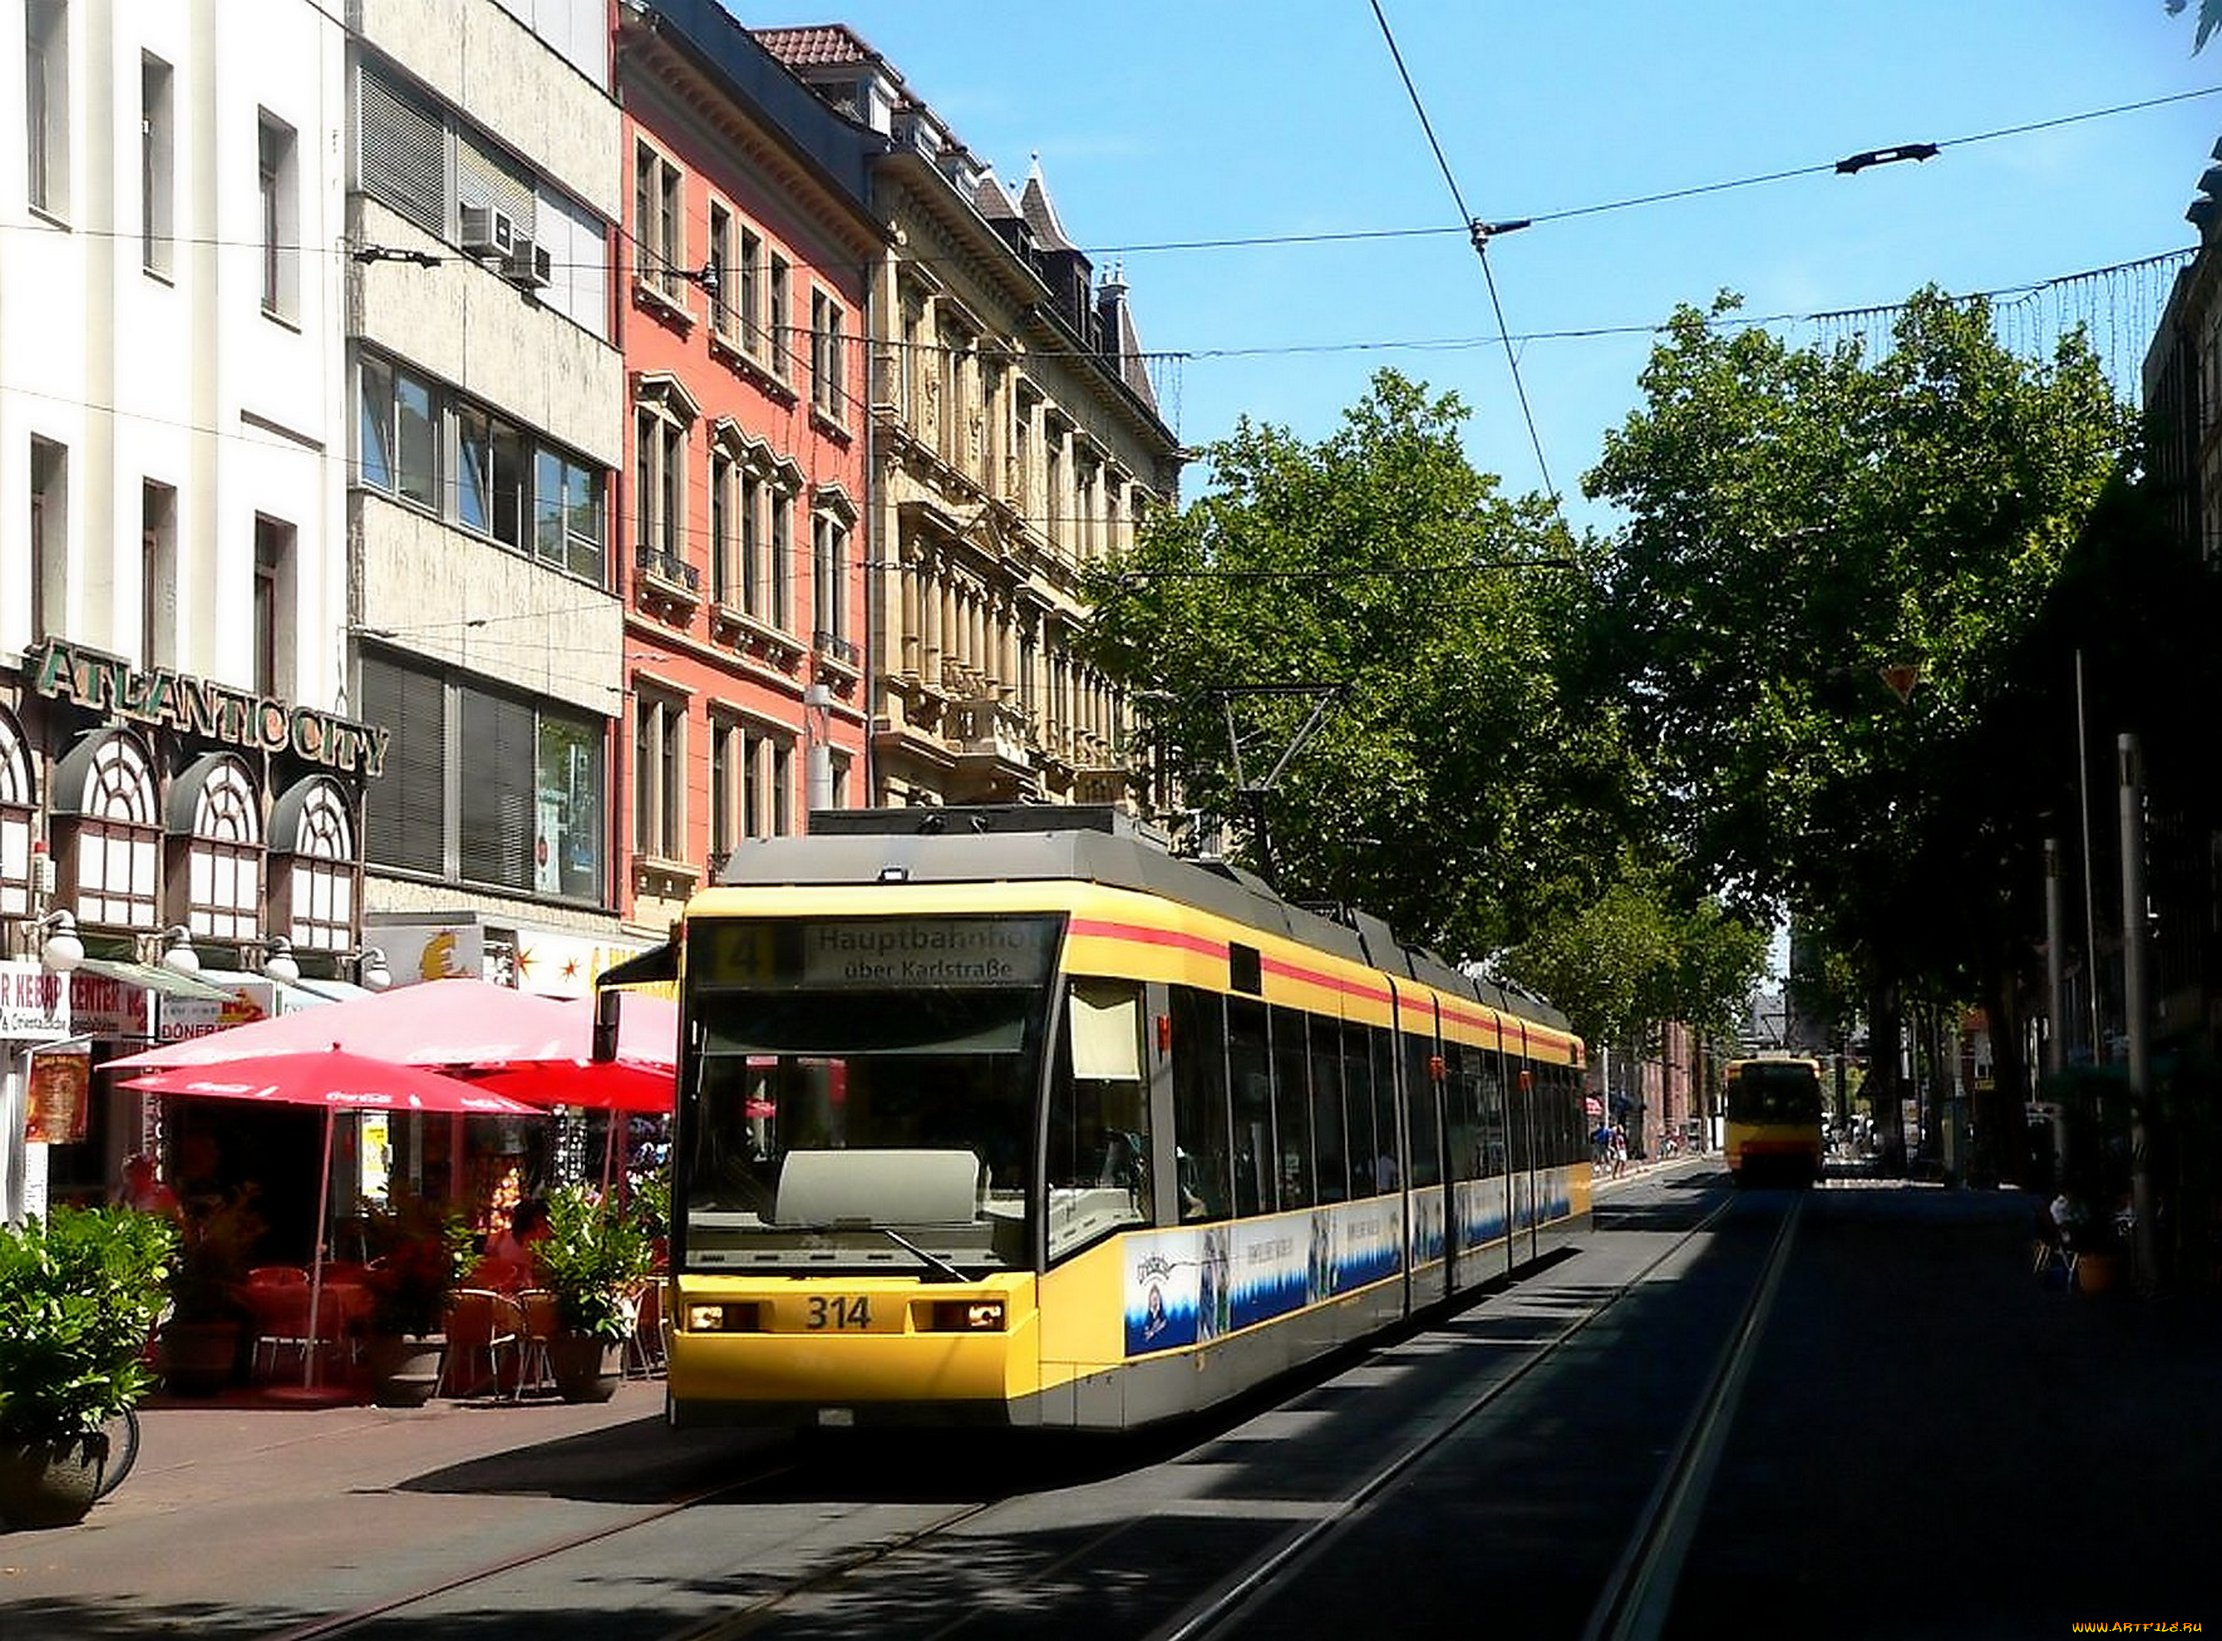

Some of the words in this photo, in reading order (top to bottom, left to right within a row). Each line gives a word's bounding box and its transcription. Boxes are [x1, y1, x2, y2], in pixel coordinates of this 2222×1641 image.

[36, 636, 290, 753] ATLANTIC
[291, 706, 391, 777] CITY
[728, 925, 761, 974] 4
[844, 959, 895, 979] über
[901, 957, 1014, 979] Karlstraße
[806, 1296, 873, 1330] 314
